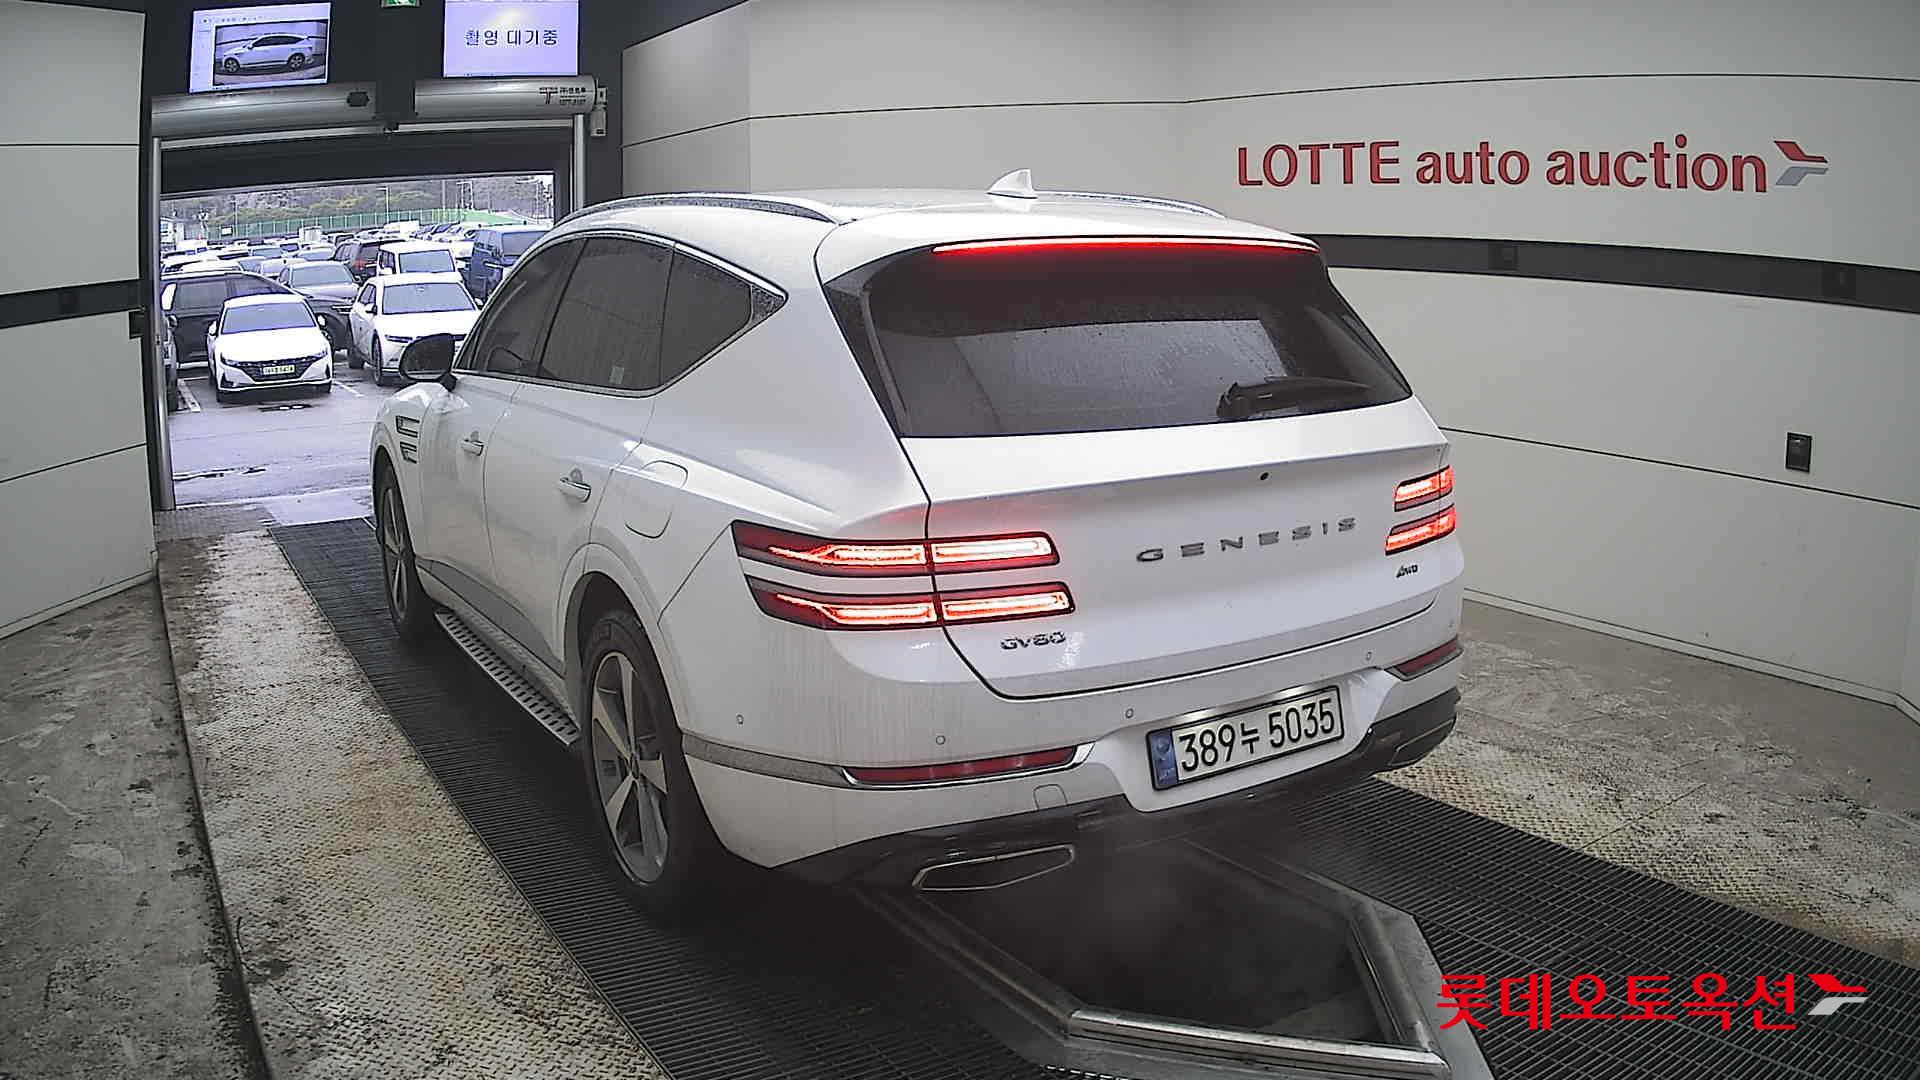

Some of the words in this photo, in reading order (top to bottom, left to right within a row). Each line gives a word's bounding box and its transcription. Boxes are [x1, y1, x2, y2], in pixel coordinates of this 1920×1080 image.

[507, 29, 558, 46] 대기중
[1237, 140, 1400, 187] LOTTE
[1416, 140, 1530, 186] auto
[1546, 134, 1767, 193] auction
[1136, 516, 1357, 563] GENESIS
[1001, 631, 1066, 650] GV80
[1179, 722, 1260, 772] 389누
[1268, 698, 1335, 748] 5035
